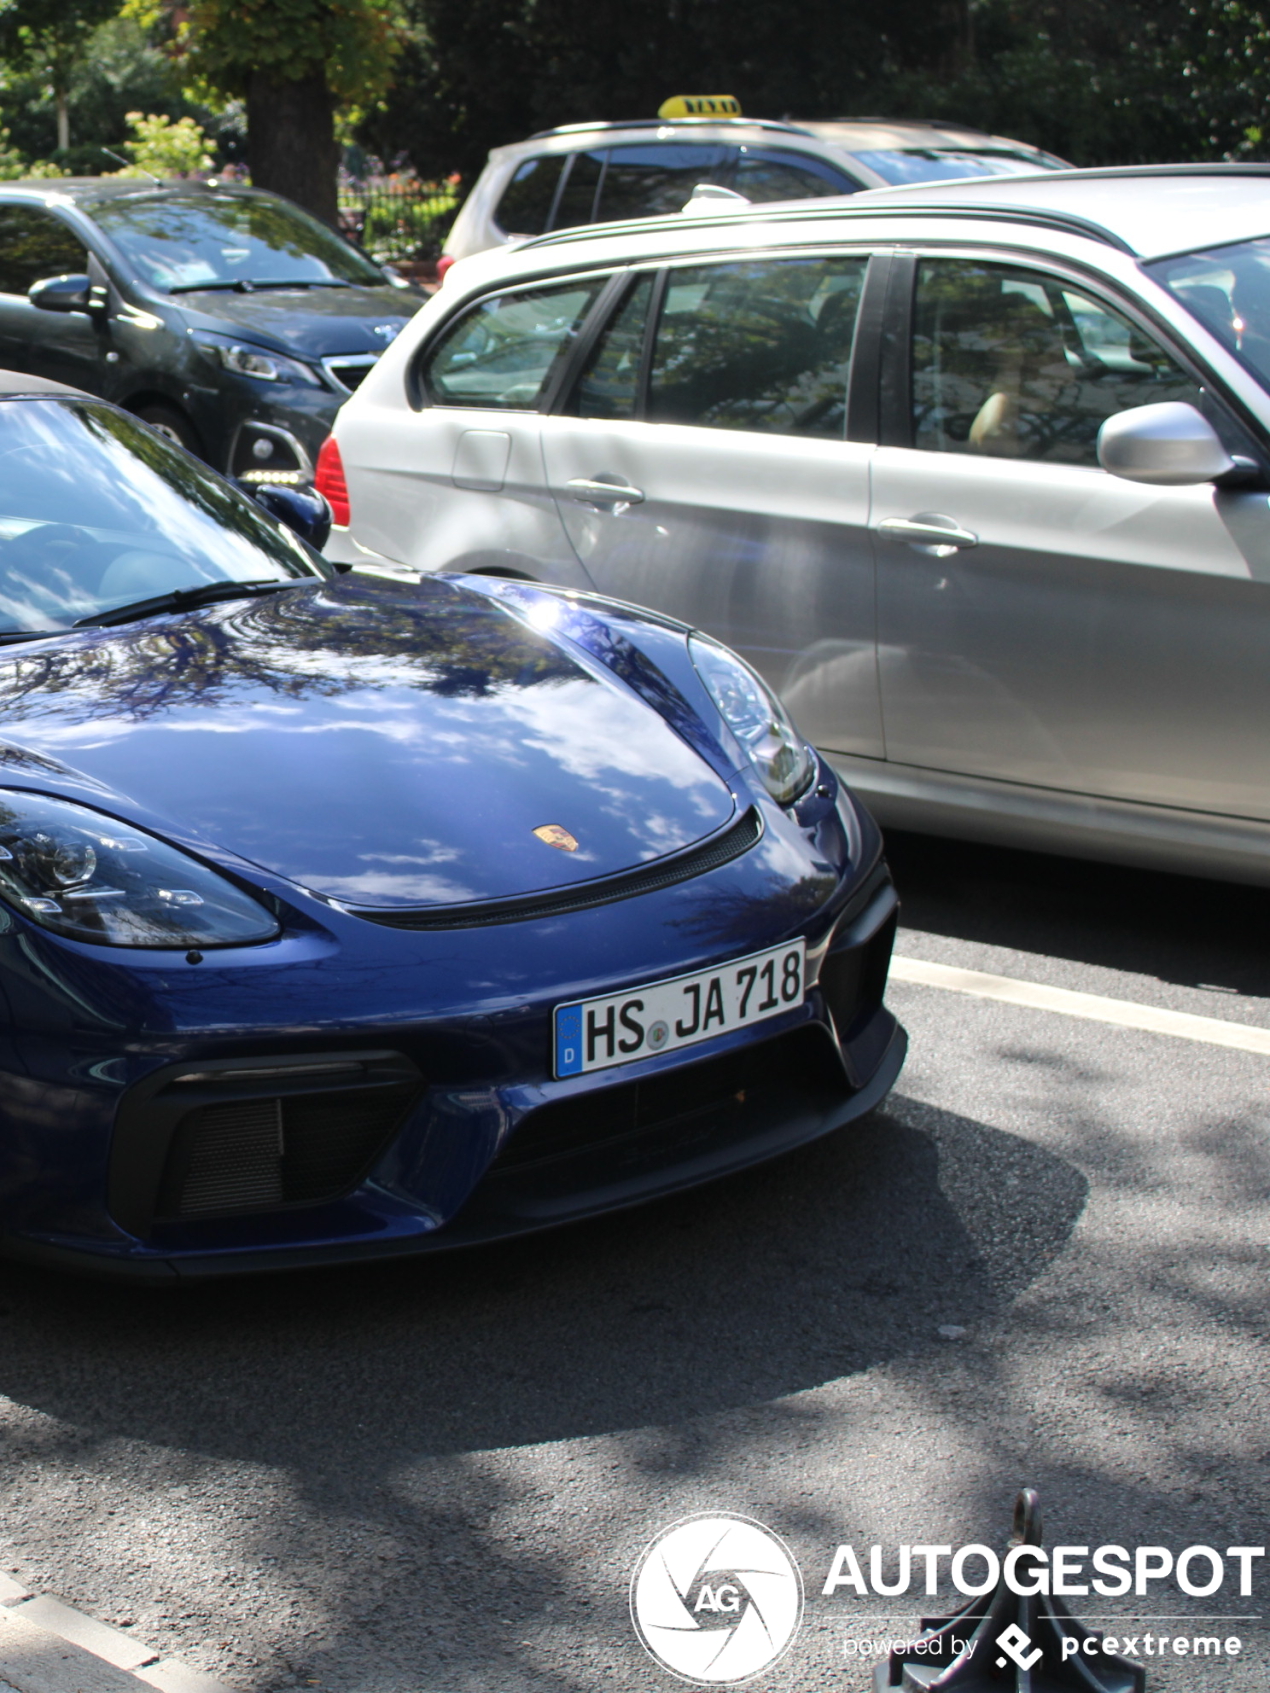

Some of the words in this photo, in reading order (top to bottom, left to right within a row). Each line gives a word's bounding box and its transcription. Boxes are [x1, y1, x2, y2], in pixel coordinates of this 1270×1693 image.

[586, 998, 645, 1062] HS
[675, 977, 725, 1038] JA
[736, 950, 800, 1019] 718
[564, 1047, 575, 1064] D
